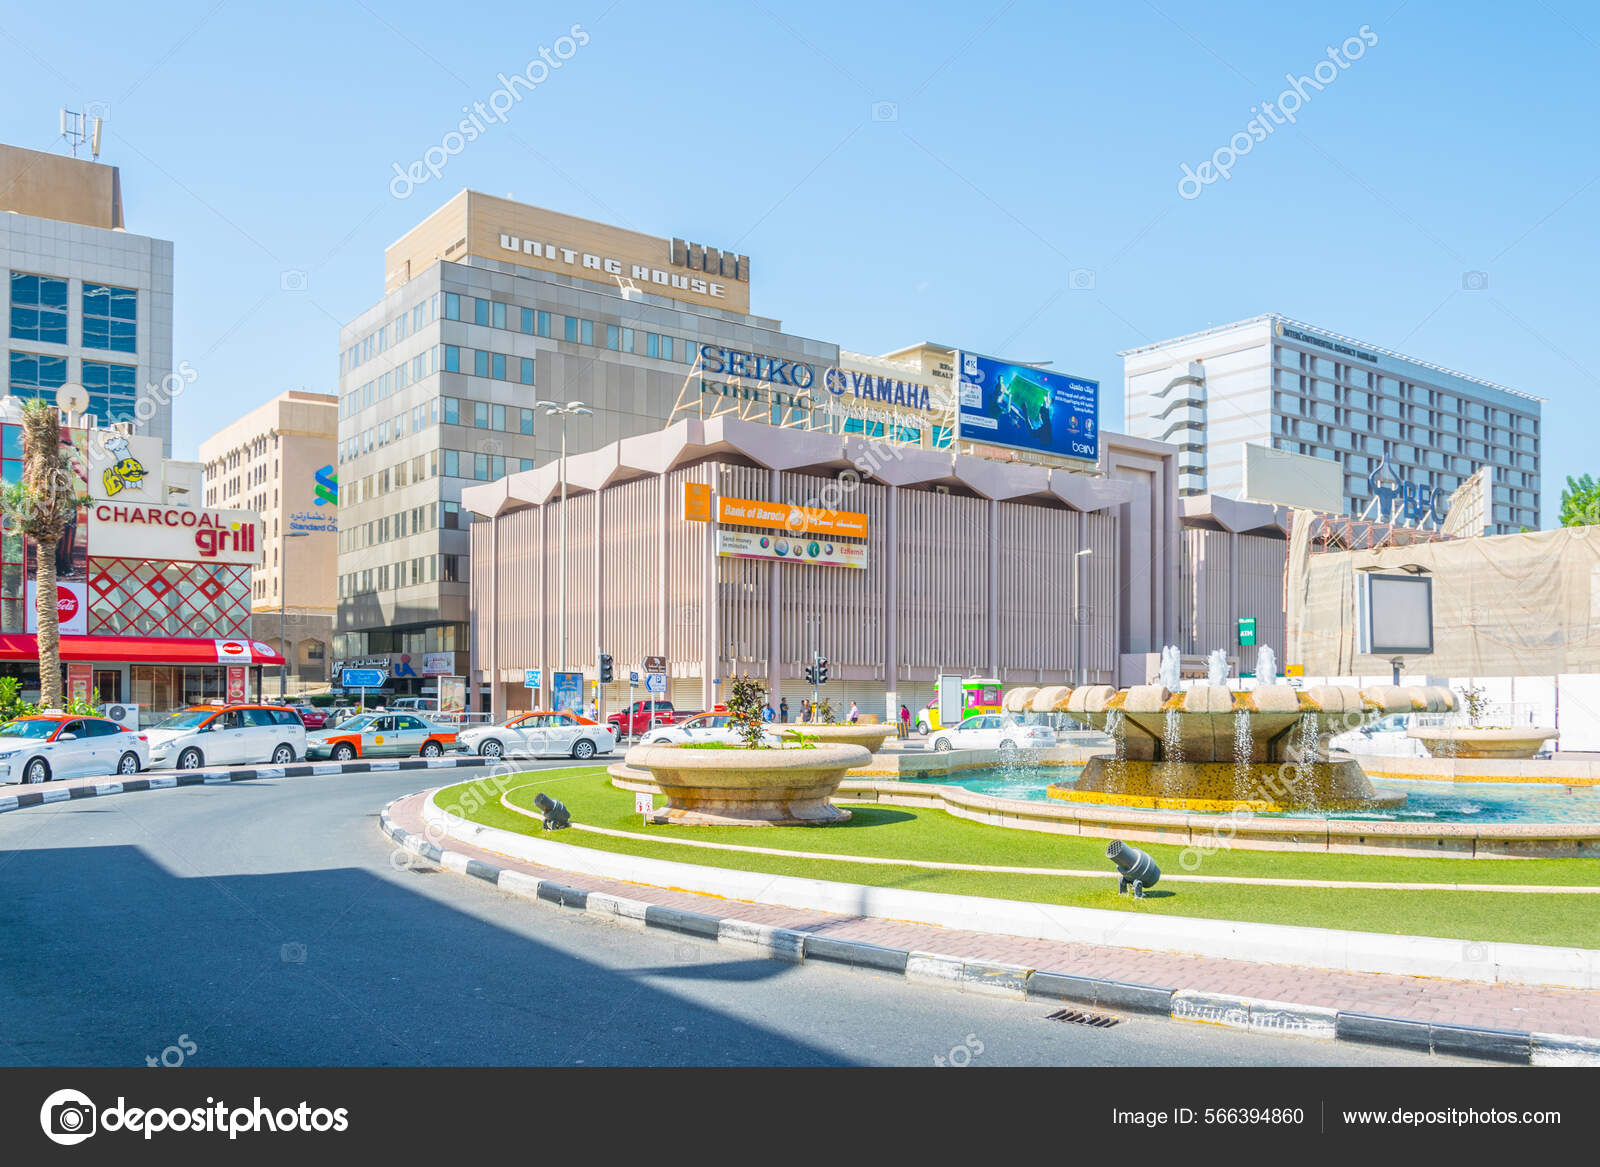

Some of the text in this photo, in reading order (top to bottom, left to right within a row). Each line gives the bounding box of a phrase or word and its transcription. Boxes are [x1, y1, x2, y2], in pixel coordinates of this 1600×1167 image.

[500, 234, 725, 298] UNITAG HOUSE
[700, 345, 814, 389] SEIKO
[850, 371, 931, 411] YAMAHA
[96, 505, 227, 529] CHARCOAL
[724, 504, 785, 522] Bank of Baroda
[1403, 480, 1445, 525] BFC
[195, 522, 254, 557] grill
[289, 522, 326, 531] Standard
[736, 538, 752, 546] money
